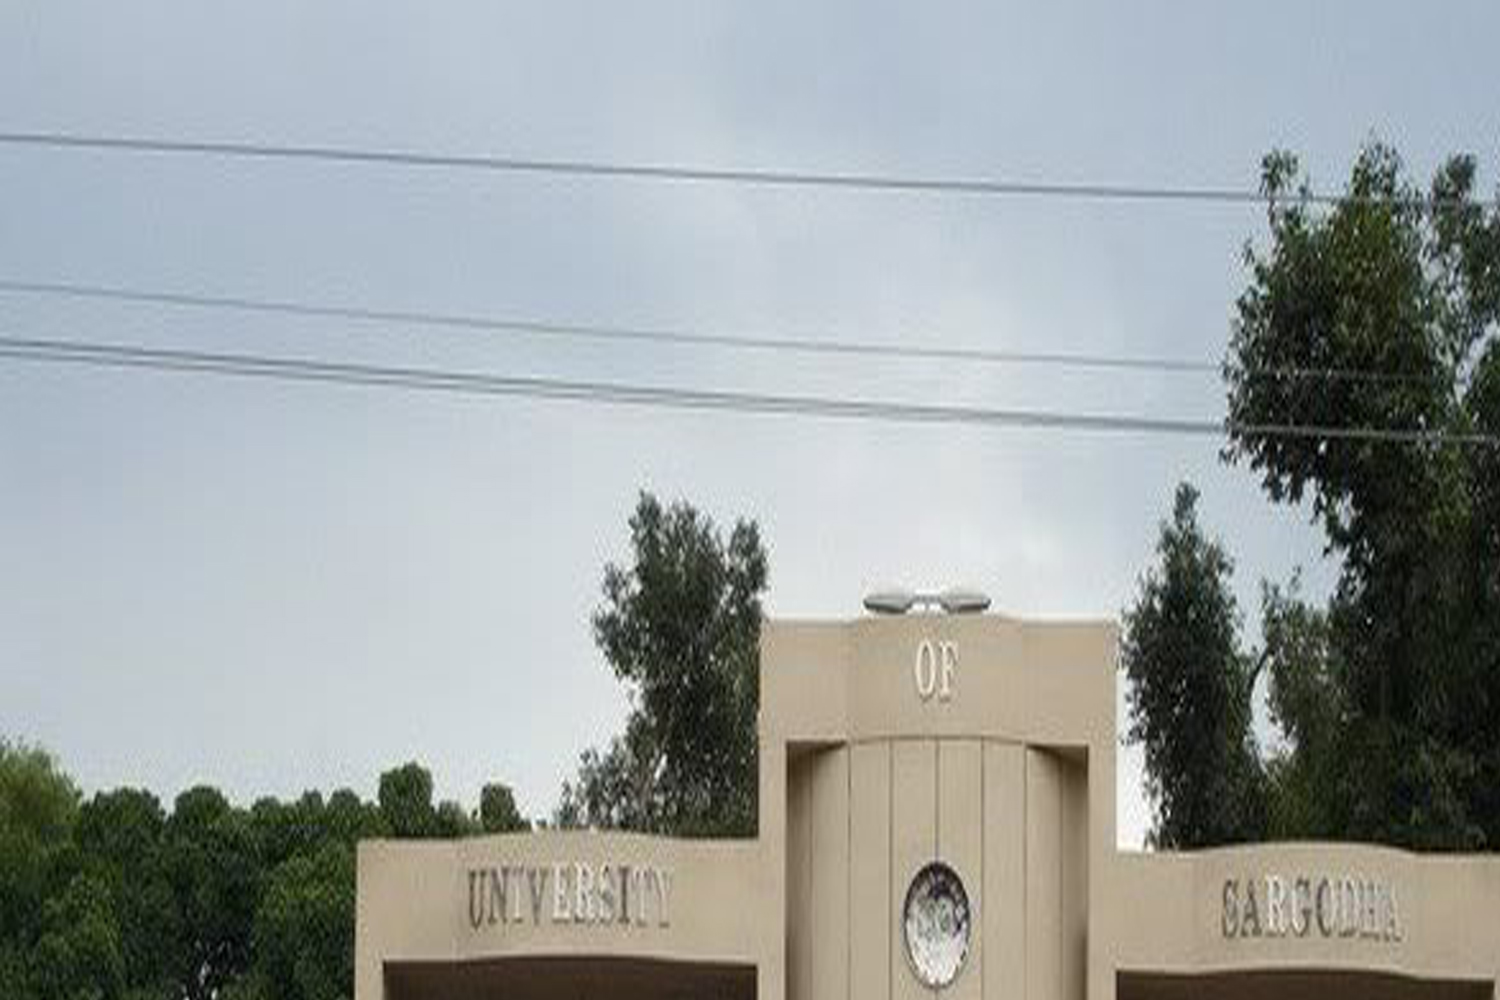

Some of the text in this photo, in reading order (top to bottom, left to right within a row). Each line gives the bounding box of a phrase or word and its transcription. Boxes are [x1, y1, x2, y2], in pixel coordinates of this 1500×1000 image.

[915, 640, 960, 702] OF
[468, 861, 673, 929] UNIVERSITY
[1221, 876, 1402, 942] SARGODHA
